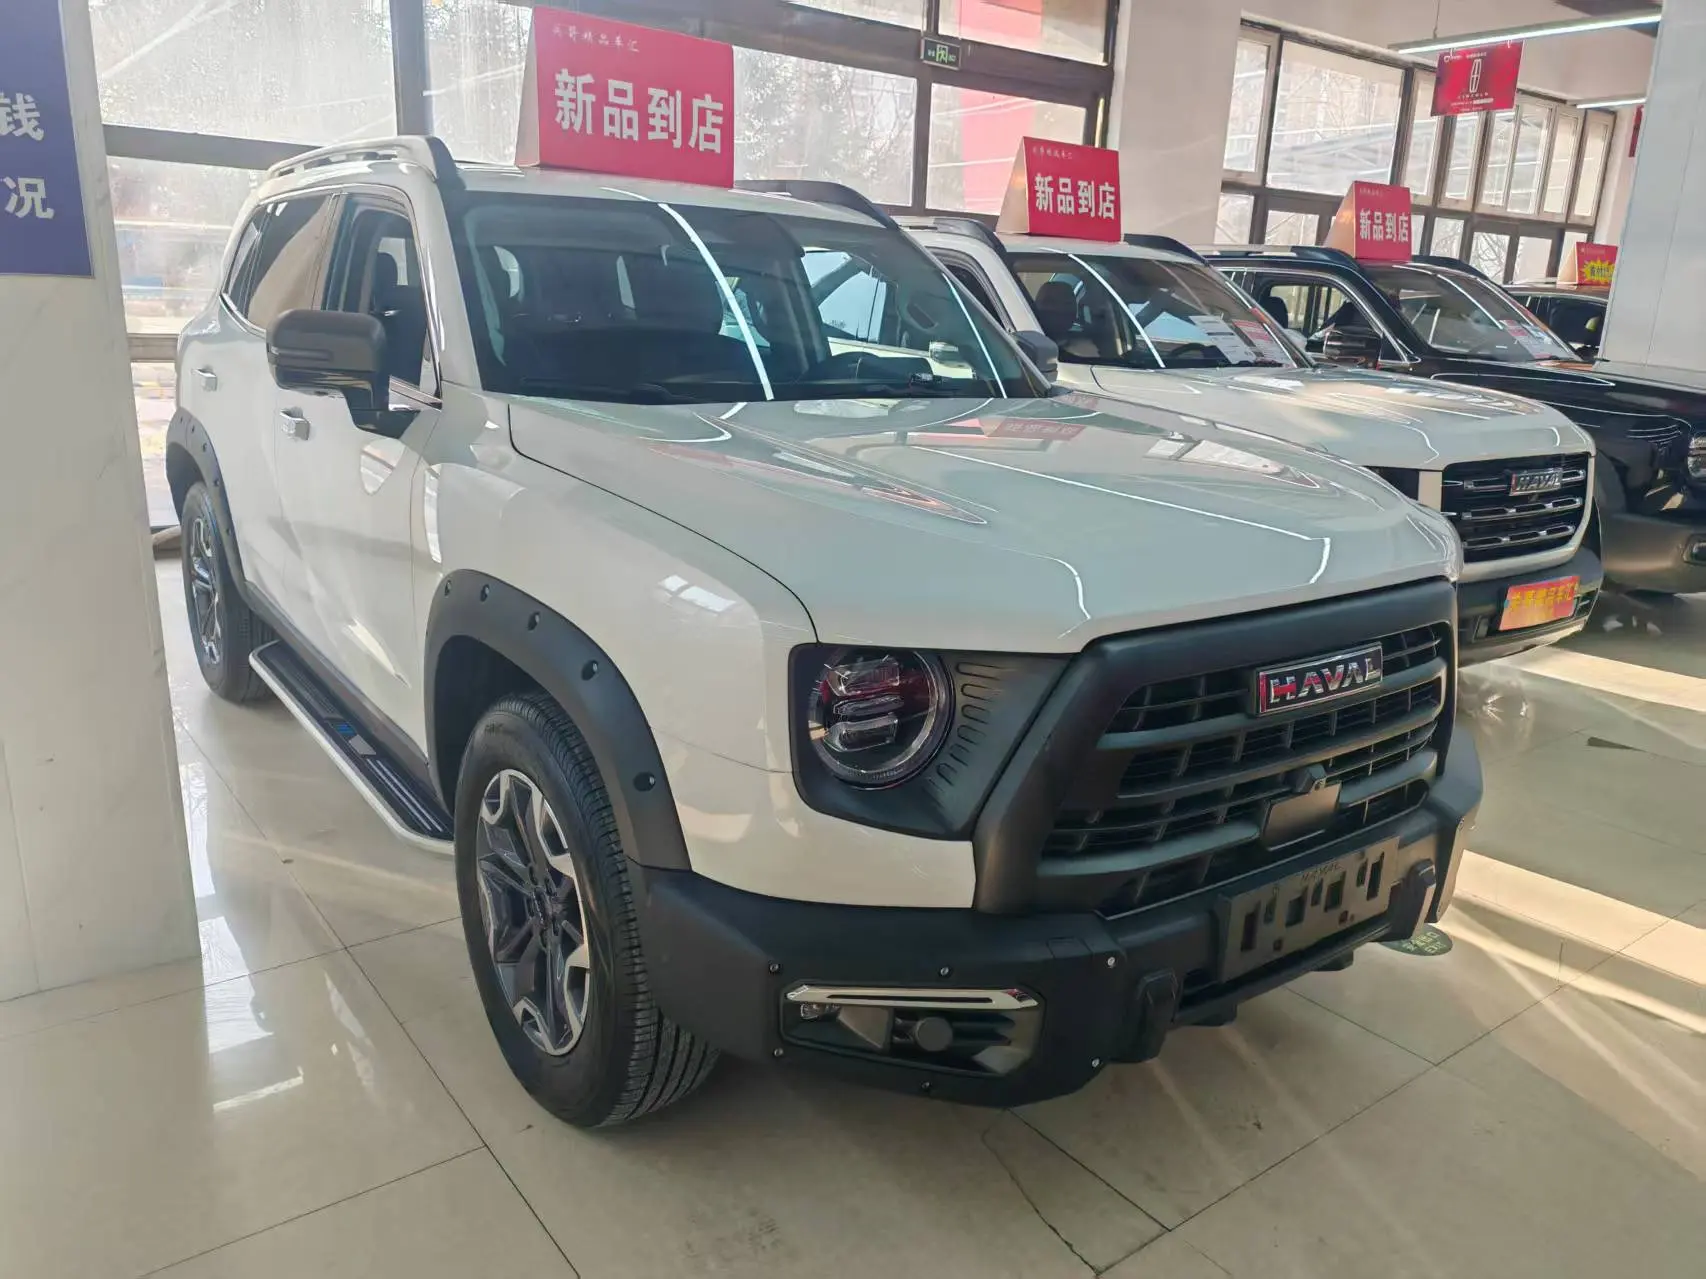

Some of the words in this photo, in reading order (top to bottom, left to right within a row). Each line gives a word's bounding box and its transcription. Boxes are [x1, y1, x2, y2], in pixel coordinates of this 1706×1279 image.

[554, 68, 724, 154] 新品到店
[1034, 172, 1116, 220] 新品到店
[1359, 208, 1409, 242] 新品到店
[1516, 472, 1561, 491] HAVAL
[1269, 656, 1382, 704] HAVAL
